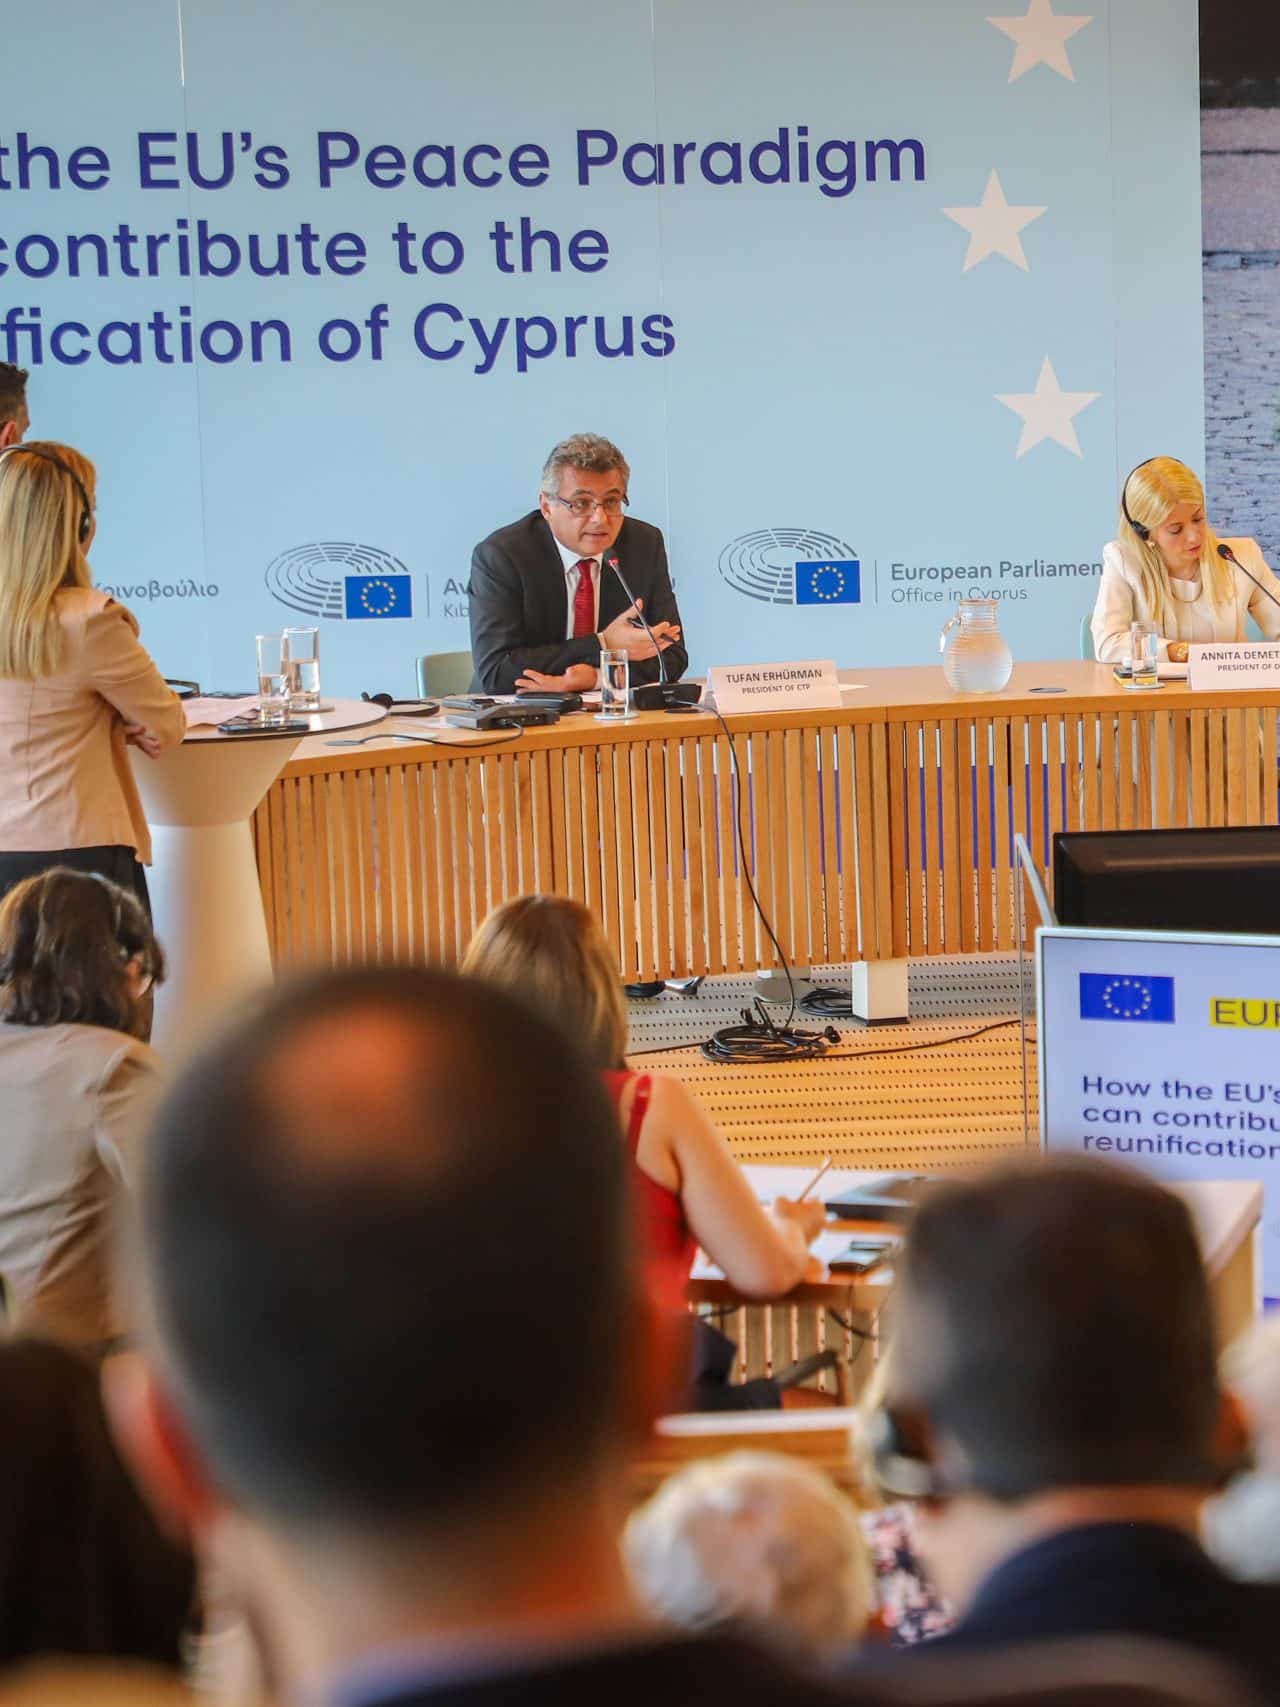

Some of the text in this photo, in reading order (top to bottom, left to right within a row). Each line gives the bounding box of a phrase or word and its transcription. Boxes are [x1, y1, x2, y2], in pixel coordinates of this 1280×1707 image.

[138, 131, 290, 190] EU's
[318, 130, 550, 189] Peace
[577, 127, 926, 198] Paradigm
[0, 217, 610, 278] ontribute to the
[318, 303, 389, 363] of
[413, 302, 677, 374] Cyprus
[891, 560, 1103, 583] European Parliamen
[891, 587, 943, 603] Office
[949, 587, 963, 600] in
[1201, 651, 1241, 661] ANNITA
[726, 669, 822, 683] TUFAN ERHÜRMAN
[742, 685, 783, 694] PRESIDENT
[1082, 1074, 1151, 1098] How
[1161, 1079, 1213, 1101] the
[1082, 1104, 1142, 1125] can
